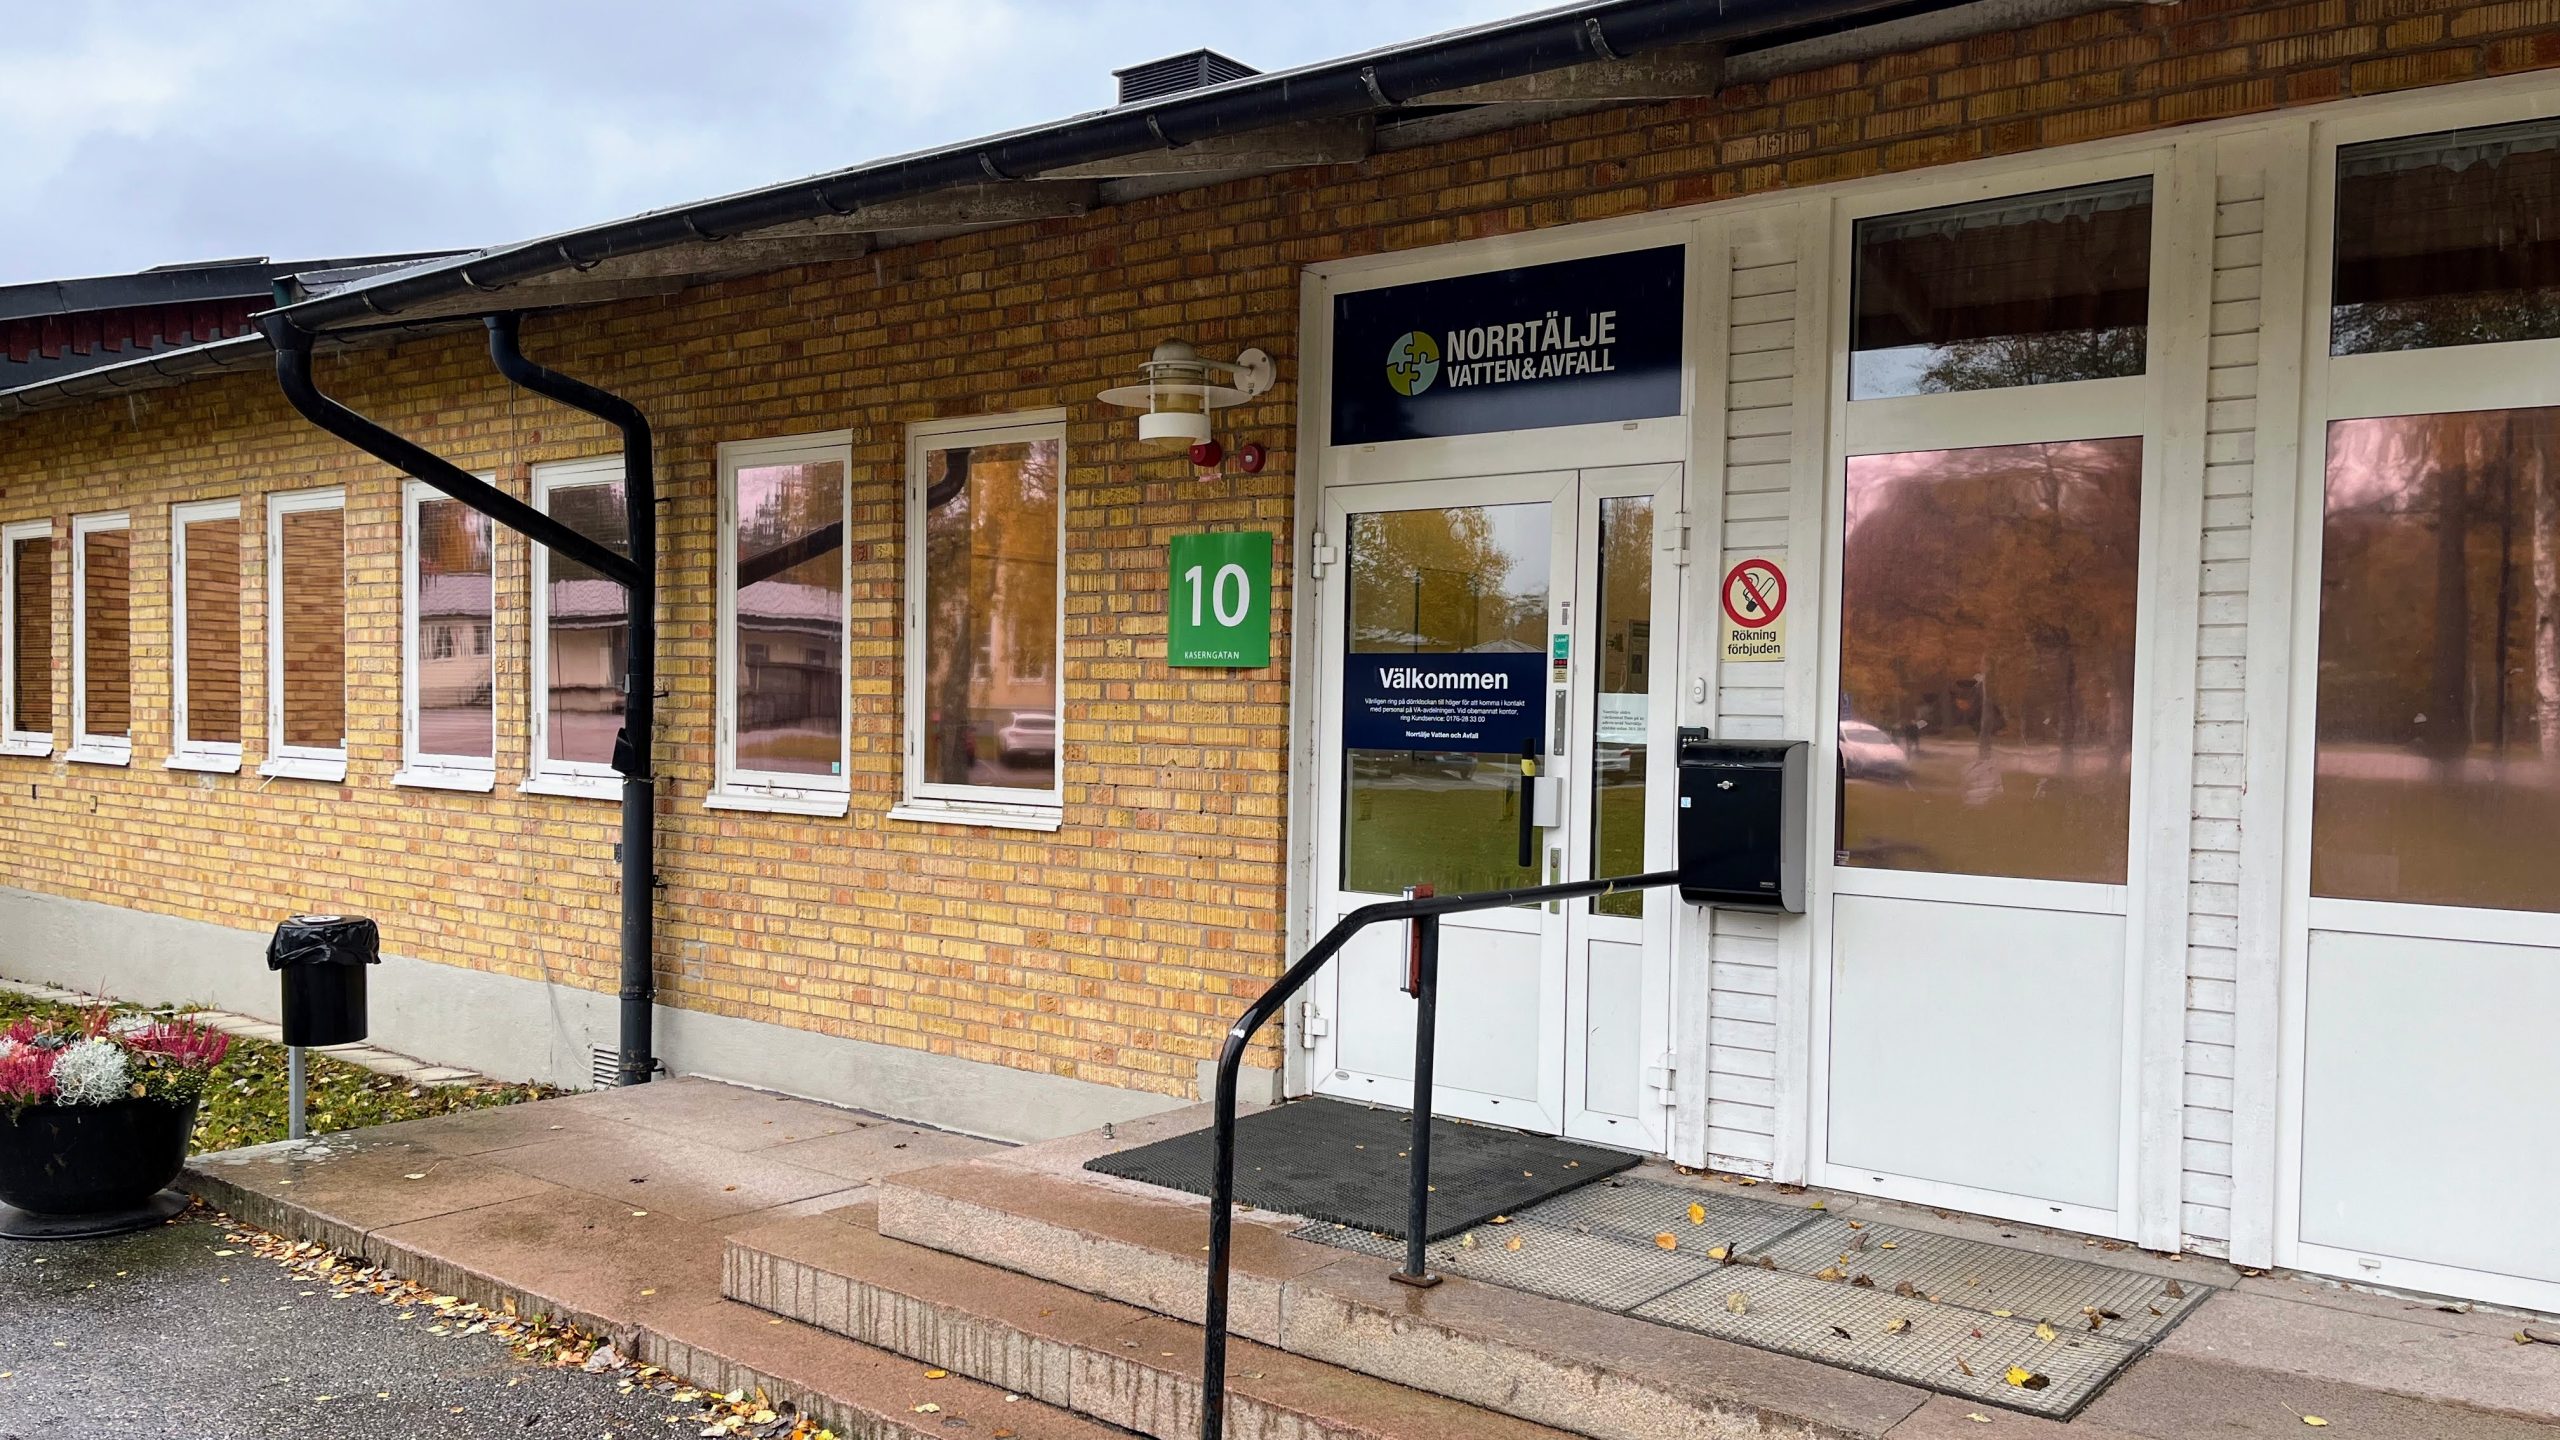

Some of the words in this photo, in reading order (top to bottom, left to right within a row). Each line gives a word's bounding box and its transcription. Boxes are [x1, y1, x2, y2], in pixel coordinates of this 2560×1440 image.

[1447, 311, 1616, 362] NORRTÄLJE
[1184, 563, 1250, 627] 10
[1732, 629, 1777, 642] Rökning
[1184, 650, 1240, 660] KASERNGATAN
[1727, 643, 1781, 656] förbjuden
[1379, 667, 1509, 690] Välkommen
[1364, 698, 1386, 706] Vänligen
[1398, 698, 1406, 706] på
[1445, 699, 1460, 707] höger
[1499, 708, 1518, 716] kontor,
